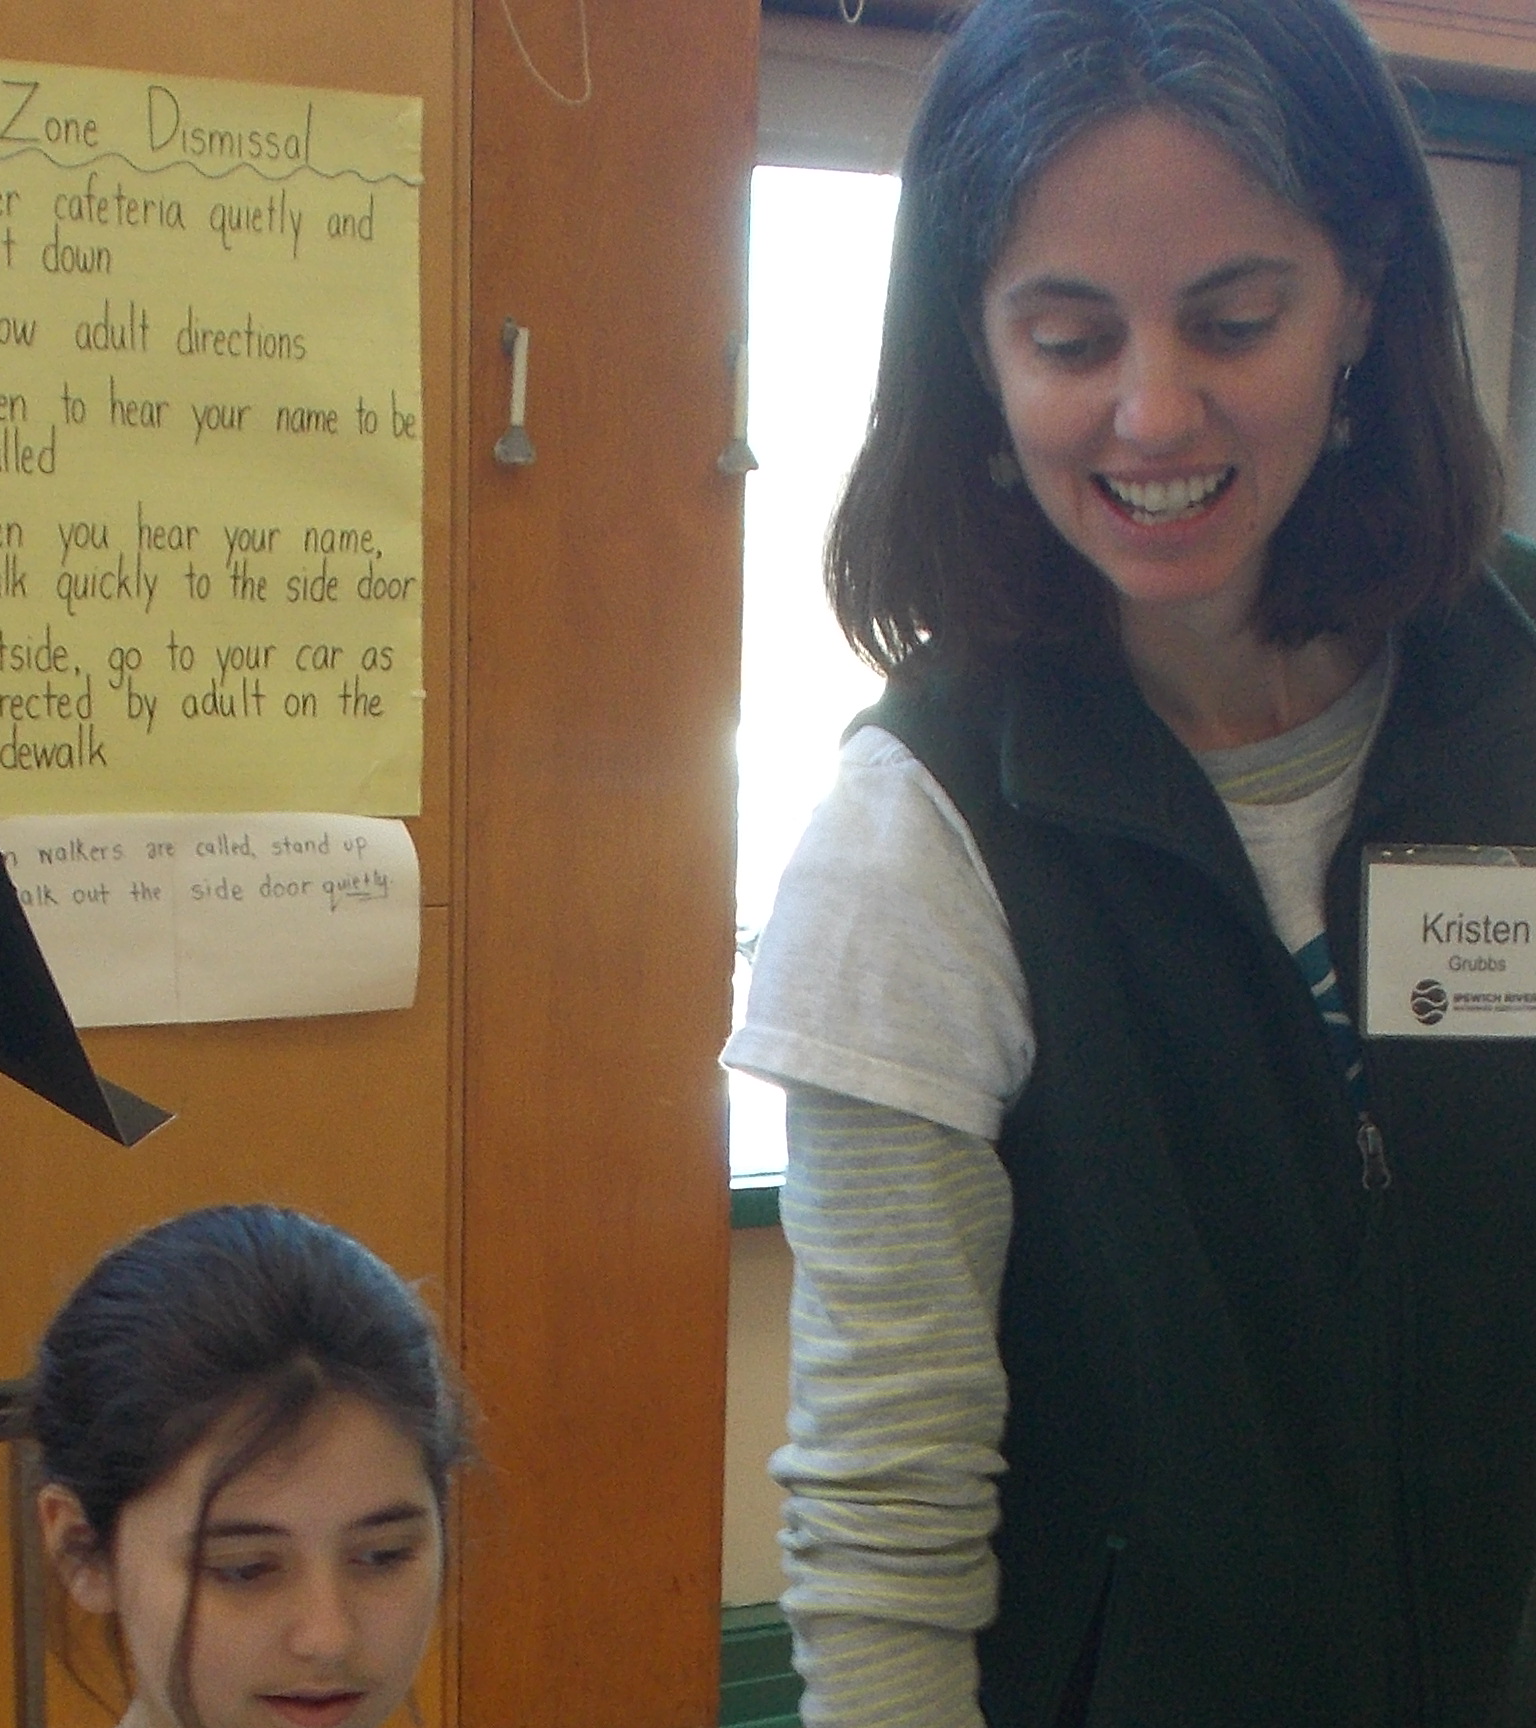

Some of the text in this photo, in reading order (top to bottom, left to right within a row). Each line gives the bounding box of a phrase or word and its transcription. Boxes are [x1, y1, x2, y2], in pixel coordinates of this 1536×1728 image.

[147, 85, 313, 163] Dismissal
[53, 172, 186, 229] cafeteria
[209, 189, 304, 260] quietly
[327, 194, 374, 241] and
[42, 225, 111, 274] down
[75, 298, 149, 353] adult
[176, 306, 307, 360] directions
[63, 383, 86, 425] to
[109, 375, 169, 430] hear
[191, 401, 252, 445] your
[276, 403, 339, 436] name
[356, 397, 379, 435] to
[392, 388, 416, 437] be
[58, 519, 109, 565] you
[138, 500, 199, 551] hear
[224, 523, 281, 570] your
[303, 523, 382, 560] name,
[56, 553, 158, 617] quickly
[185, 563, 210, 599] to
[228, 561, 267, 601] the
[286, 560, 338, 602] side
[357, 560, 416, 601] door
[109, 645, 142, 689] go
[166, 638, 195, 671] to
[216, 643, 277, 686] your
[295, 642, 343, 671] car
[362, 643, 394, 671] as
[127, 689, 157, 733] by
[182, 677, 263, 718] adult
[284, 691, 317, 716] on
[338, 677, 384, 717] the
[38, 838, 123, 866] walkers
[146, 840, 175, 860] are
[271, 832, 328, 856] stand
[343, 836, 367, 860] up
[18, 882, 58, 906] alk
[72, 883, 109, 905] out
[130, 881, 162, 901] the
[190, 878, 244, 902] side
[259, 874, 311, 898] door
[1422, 912, 1530, 944] Kristen
[1448, 954, 1506, 972] Grubbs
